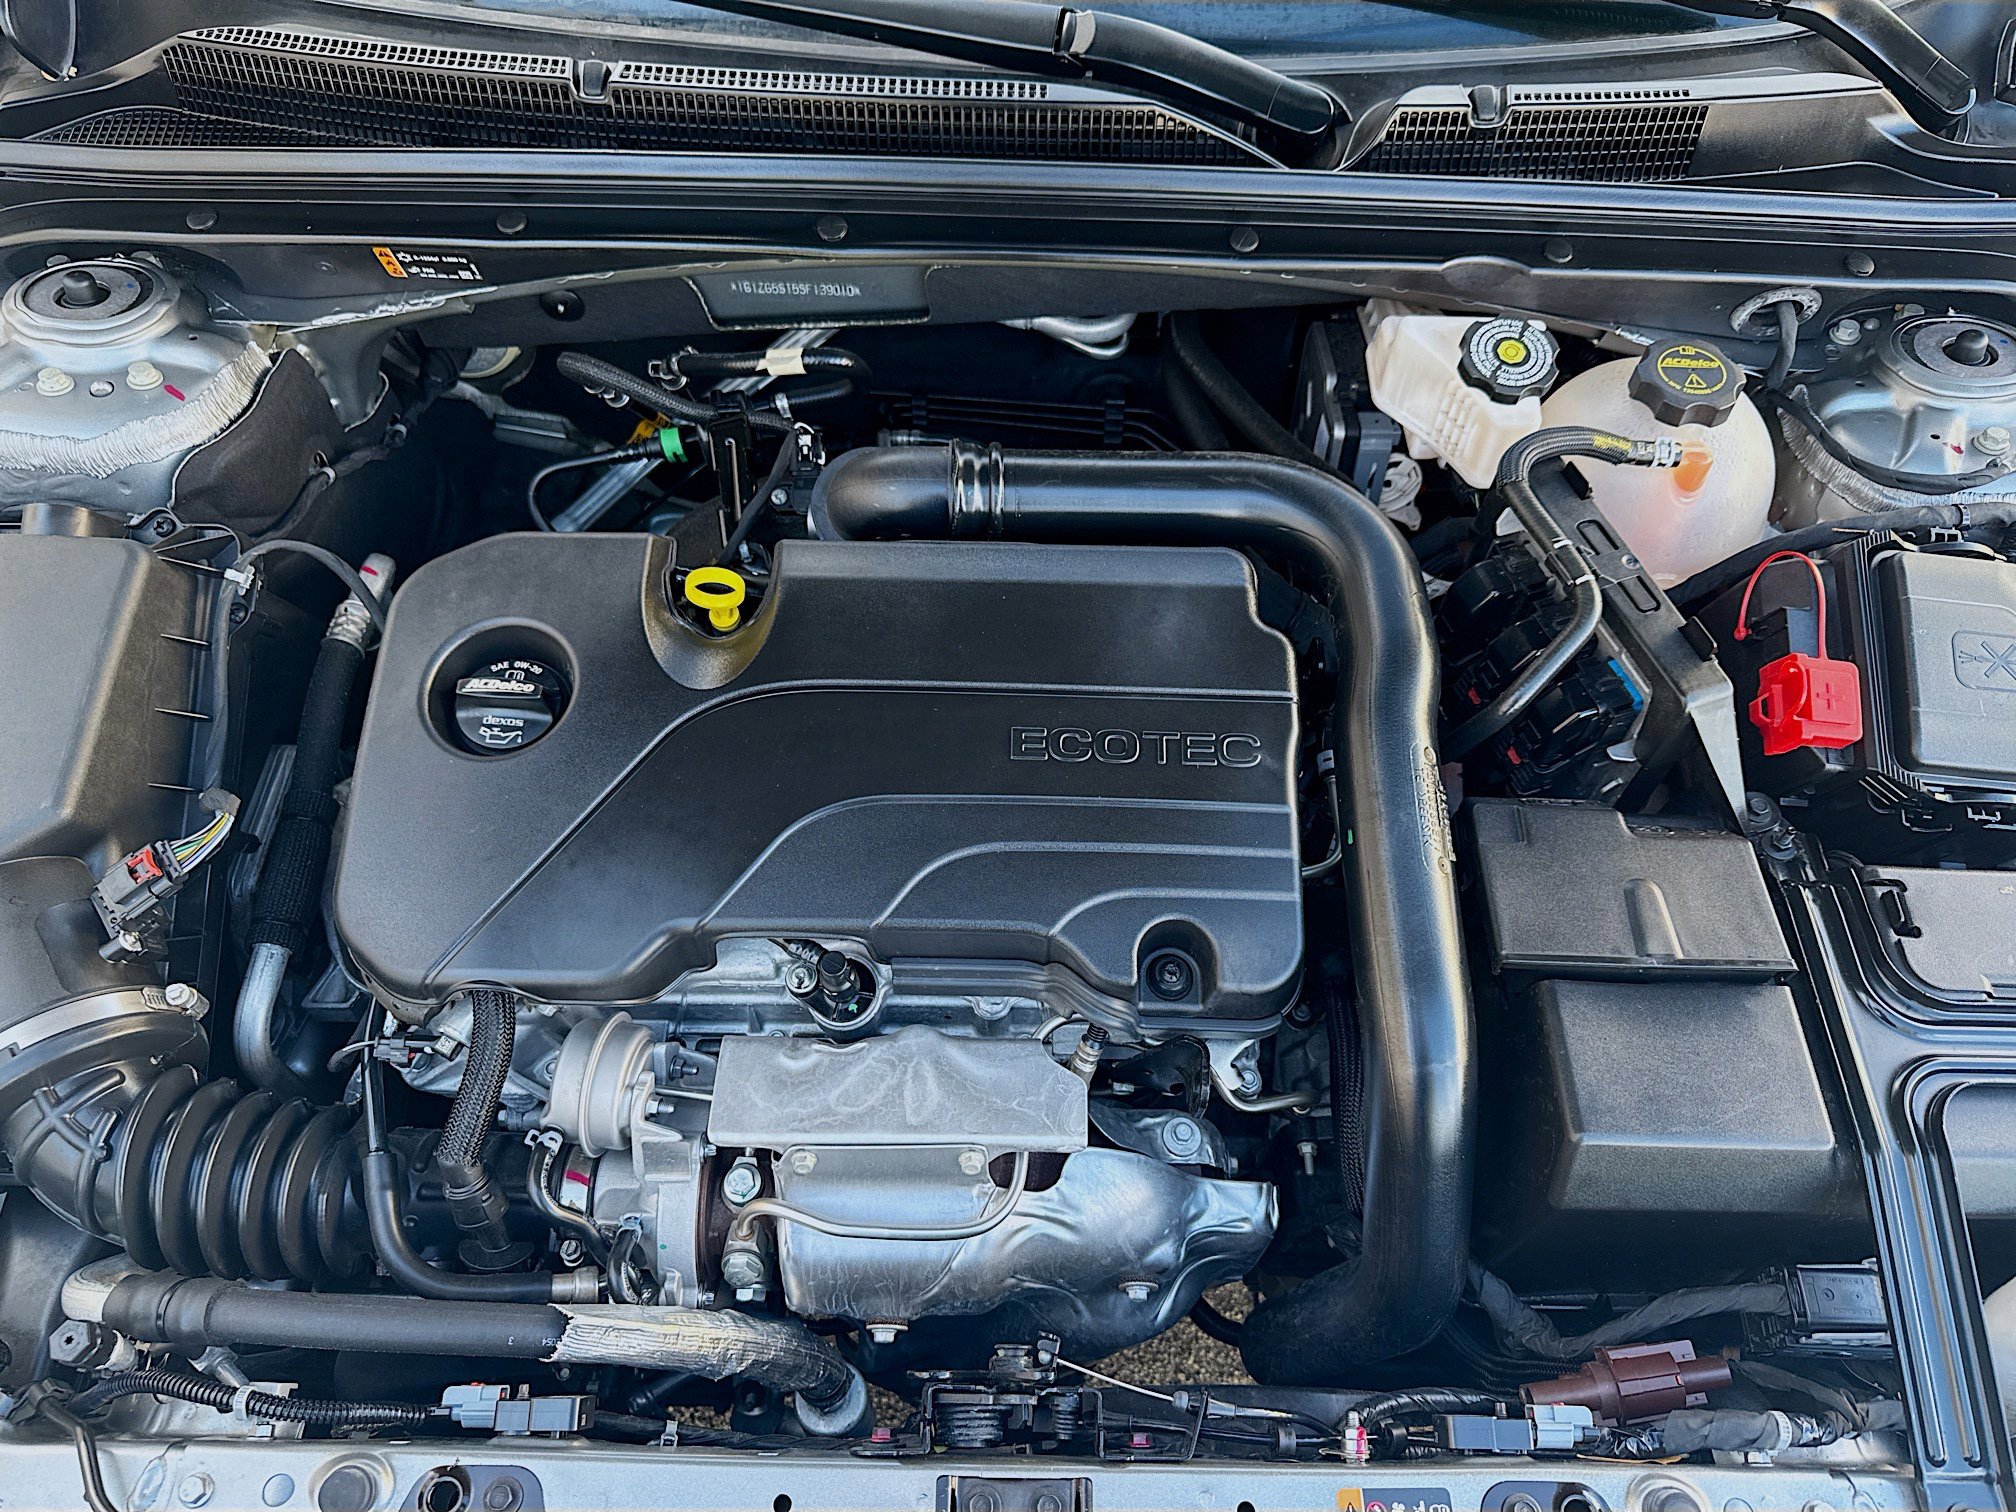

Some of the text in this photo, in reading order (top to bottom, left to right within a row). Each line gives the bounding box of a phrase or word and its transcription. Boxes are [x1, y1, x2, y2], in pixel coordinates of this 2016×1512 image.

[1660, 357, 1720, 368] ACDelco
[490, 661, 510, 672] SAE
[461, 679, 536, 692] ACDelco
[482, 714, 524, 727] dexos
[1010, 726, 1261, 768] ECOTEC
